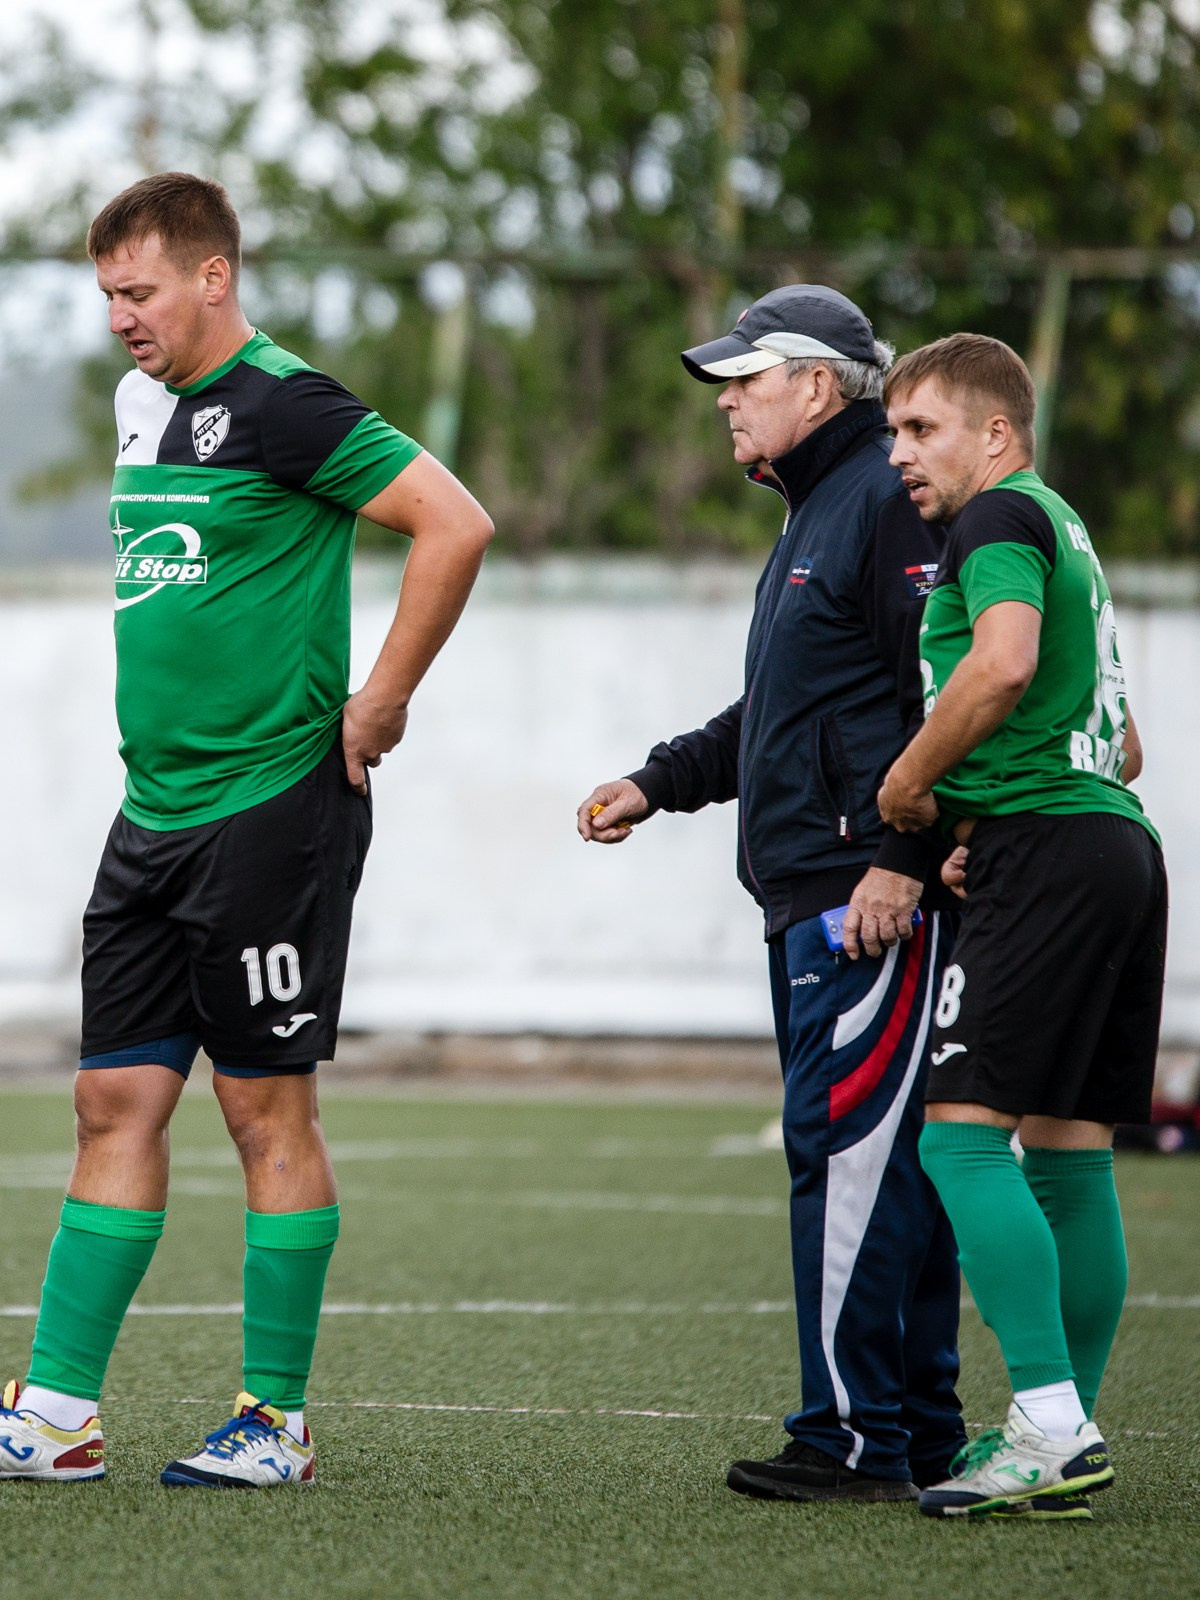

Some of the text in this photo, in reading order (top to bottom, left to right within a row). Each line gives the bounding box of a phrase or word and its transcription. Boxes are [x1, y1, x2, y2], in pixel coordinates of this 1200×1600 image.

[166, 494, 210, 504] КОМПАНИЯ
[115, 557, 203, 581] it Stop
[241, 943, 302, 1006] 10
[935, 964, 966, 1028] 8
